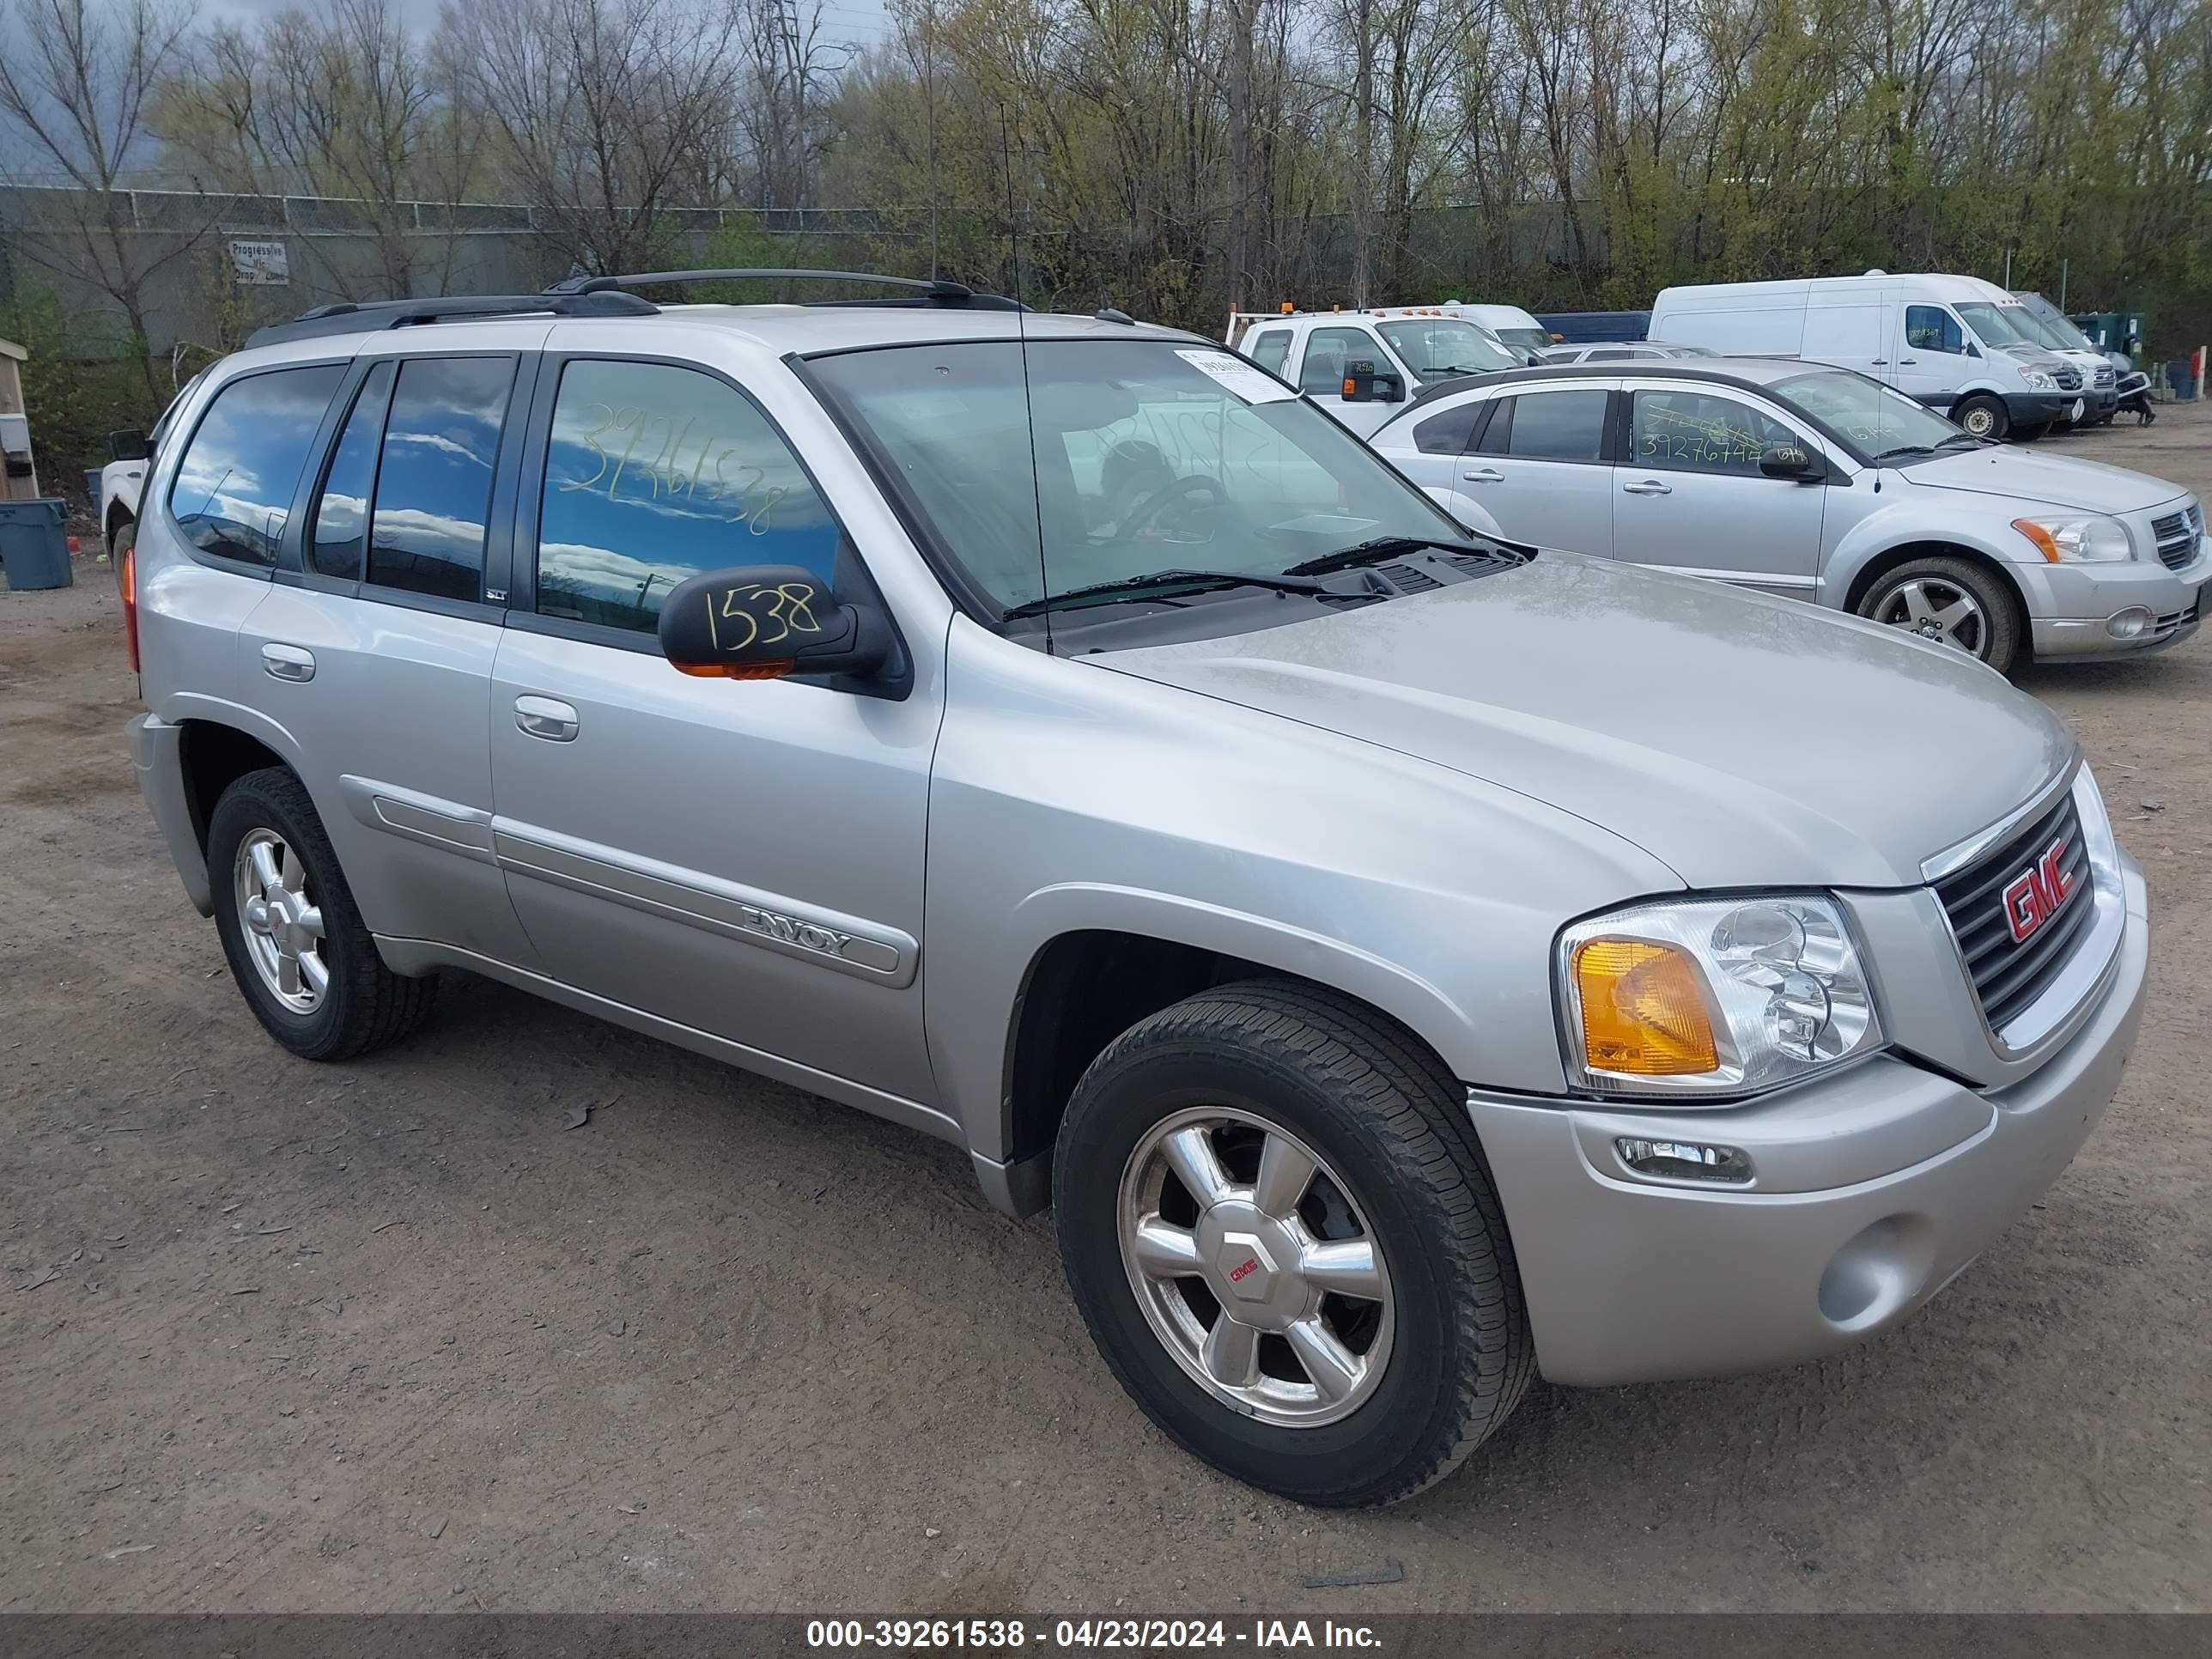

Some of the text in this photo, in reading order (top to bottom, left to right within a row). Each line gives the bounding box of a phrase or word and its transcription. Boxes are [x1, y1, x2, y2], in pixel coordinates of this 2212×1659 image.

[233, 243, 282, 258] Progressive
[559, 403, 788, 536] 39261538
[486, 587, 508, 600] SLT
[707, 583, 822, 651] 1538
[2002, 837, 2075, 943] GMC
[741, 906, 852, 956] ENVOY
[1230, 1257, 1258, 1283] GMC
